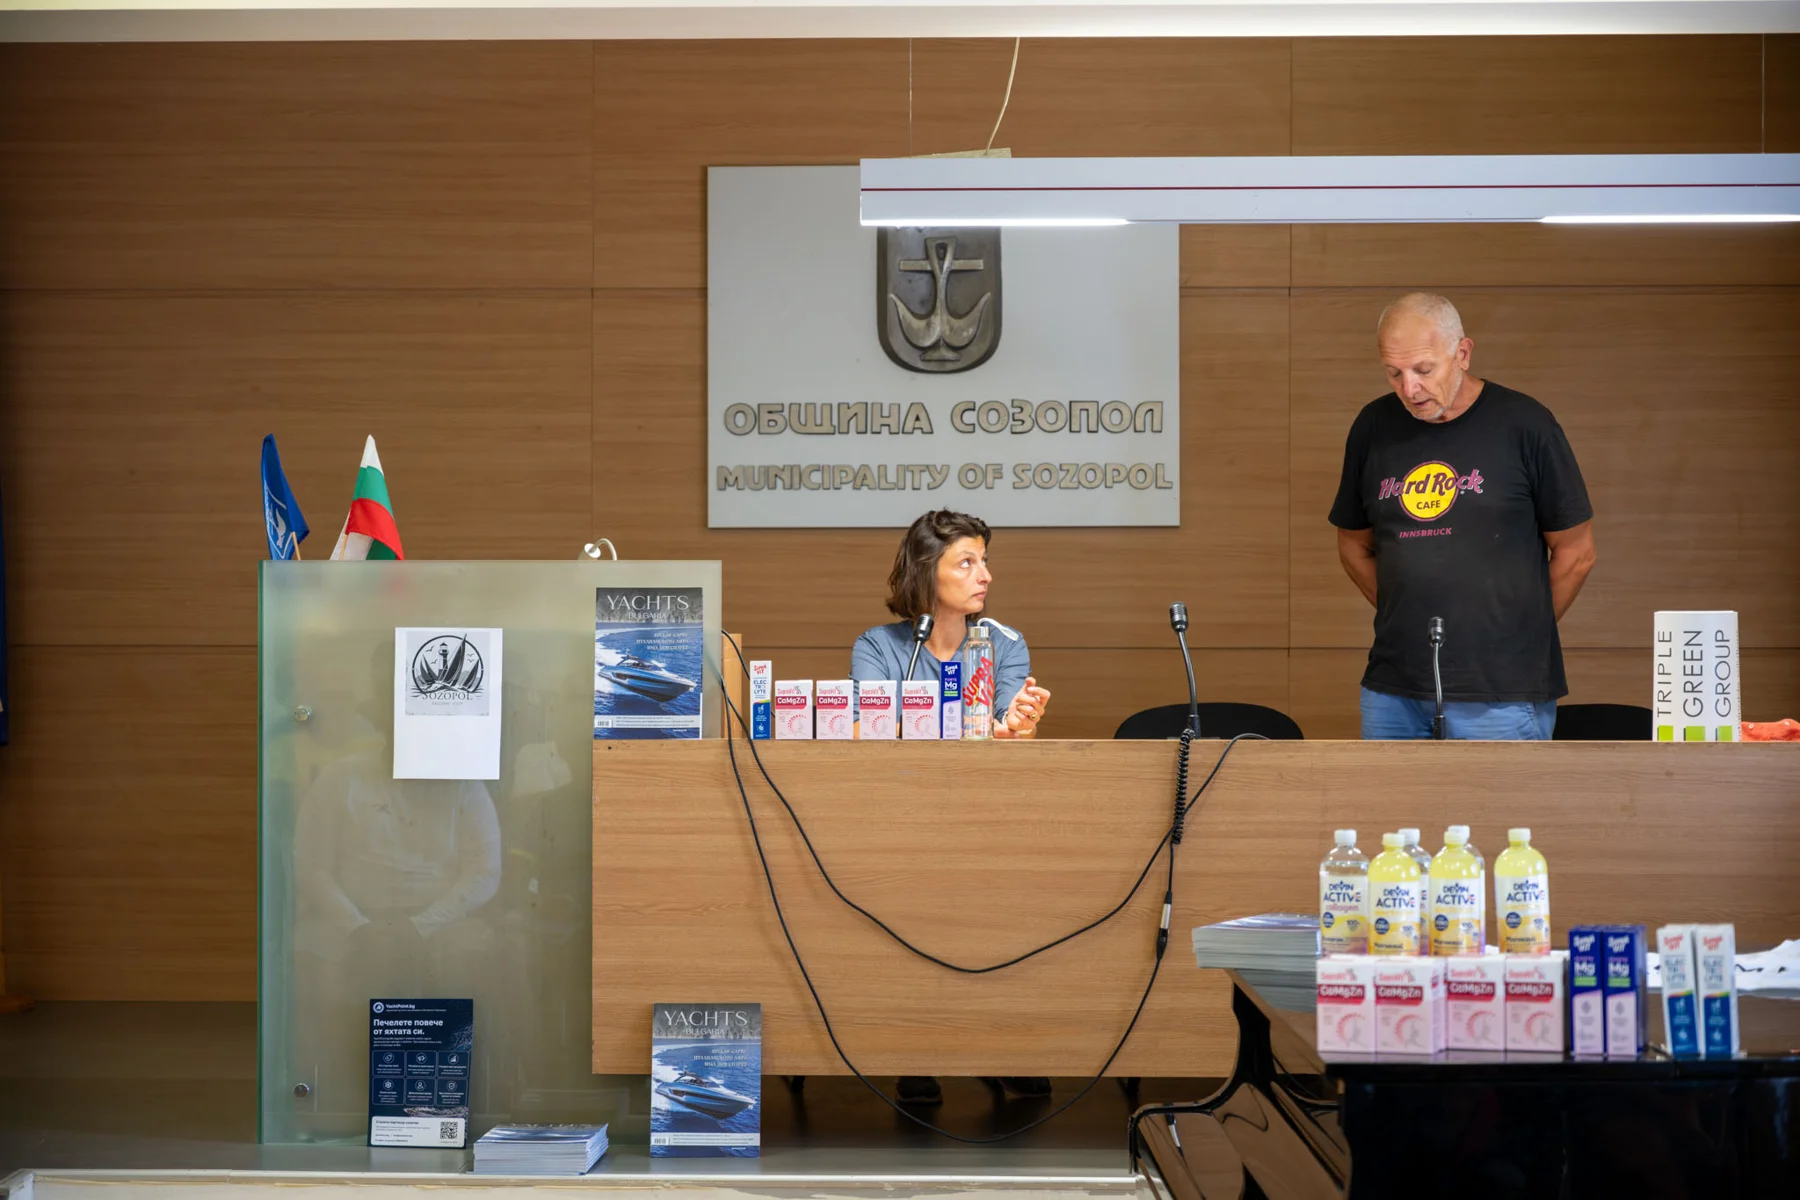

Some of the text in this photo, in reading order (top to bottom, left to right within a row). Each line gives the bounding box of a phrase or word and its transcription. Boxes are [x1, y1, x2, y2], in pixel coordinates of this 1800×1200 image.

[723, 399, 1164, 436] ОБЩИНА СОЗОПОЛ
[716, 462, 1174, 491] MUNICIPALITY OF SOZOPOL
[1378, 469, 1484, 500] Hard Rock
[1416, 500, 1441, 510] CAFE
[1399, 527, 1453, 539] INNSBRUCK
[607, 595, 690, 611] YACHTS
[1657, 631, 1673, 718] TRIPLE
[1683, 630, 1704, 718] GREEN
[1714, 629, 1731, 718] GROUP
[944, 682, 958, 690] Mg
[422, 691, 473, 700] SOZOPOL
[777, 697, 805, 705] CaMgZn
[818, 697, 846, 705] CaMgZn
[861, 697, 889, 705] CaMgZn
[904, 697, 932, 705] CaMgZn
[1328, 881, 1354, 891] DEVIN
[1383, 886, 1410, 896] DEVIN
[1443, 883, 1469, 894] DEVIN
[1513, 880, 1539, 891] DEVIN
[1323, 892, 1361, 902] ACTIVE
[1436, 894, 1475, 905] ACTIVE
[1506, 890, 1545, 903] ACTIVE
[1376, 897, 1416, 908] ACTIVE
[664, 1010, 748, 1026] YACHTS
